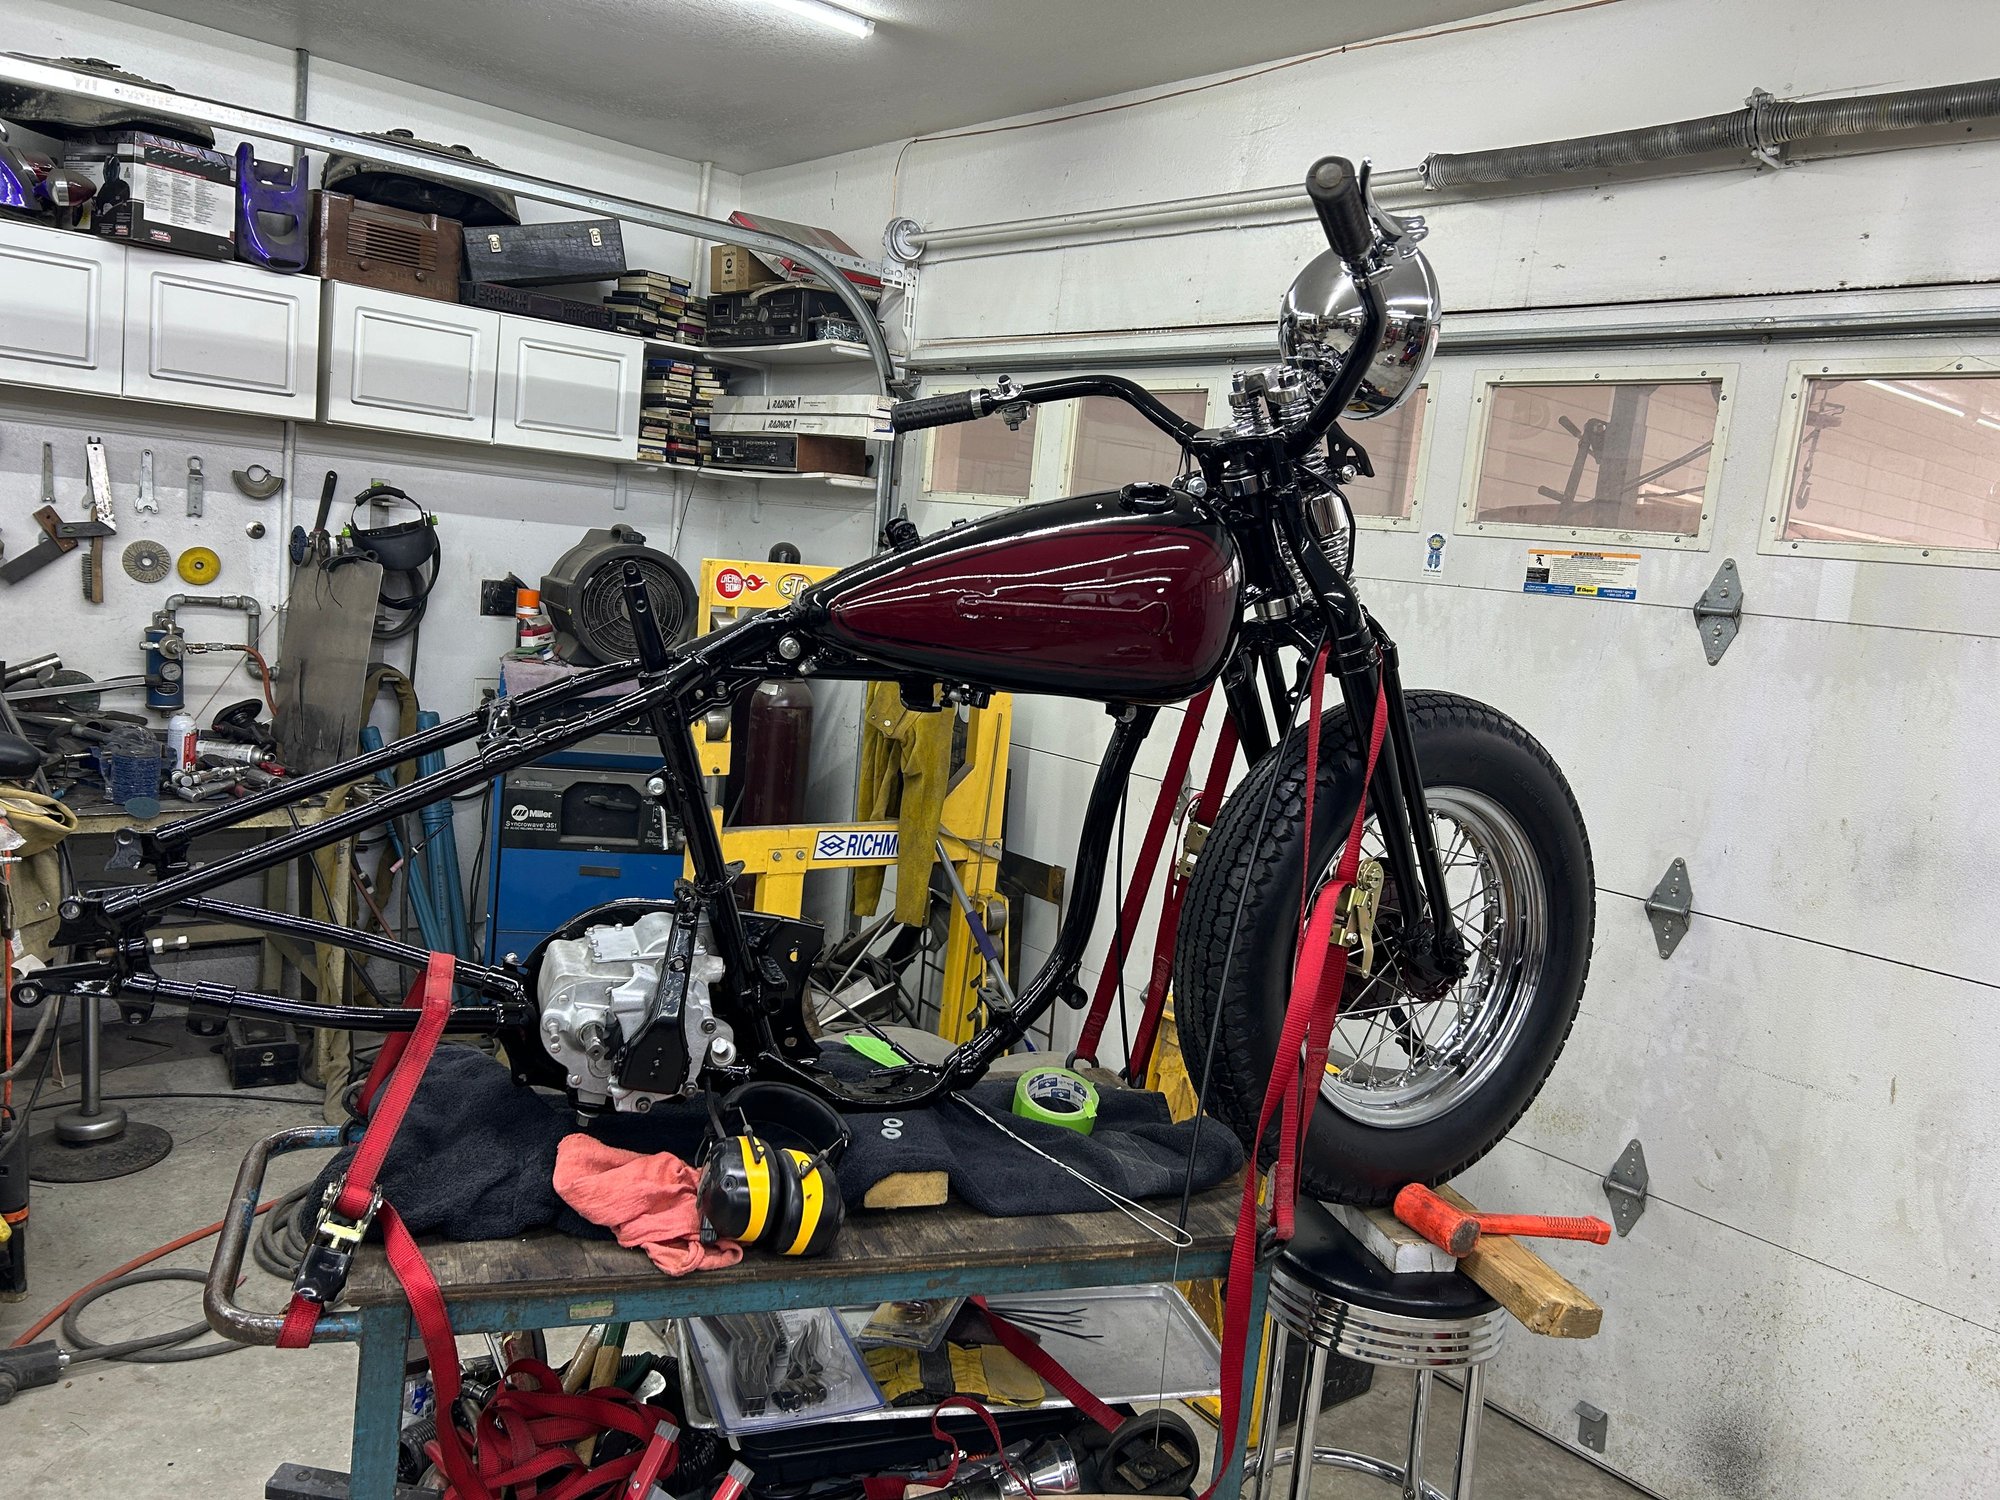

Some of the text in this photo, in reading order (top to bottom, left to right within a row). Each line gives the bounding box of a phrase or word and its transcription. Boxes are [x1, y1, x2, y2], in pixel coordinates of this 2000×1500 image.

[772, 399, 796, 409] RADNOR
[768, 420, 792, 429] RADNOR
[725, 583, 741, 593] BOMB
[781, 576, 810, 596] STP
[529, 809, 553, 818] Miller
[505, 820, 544, 828] Syncrowave
[846, 833, 899, 856] RICHM
